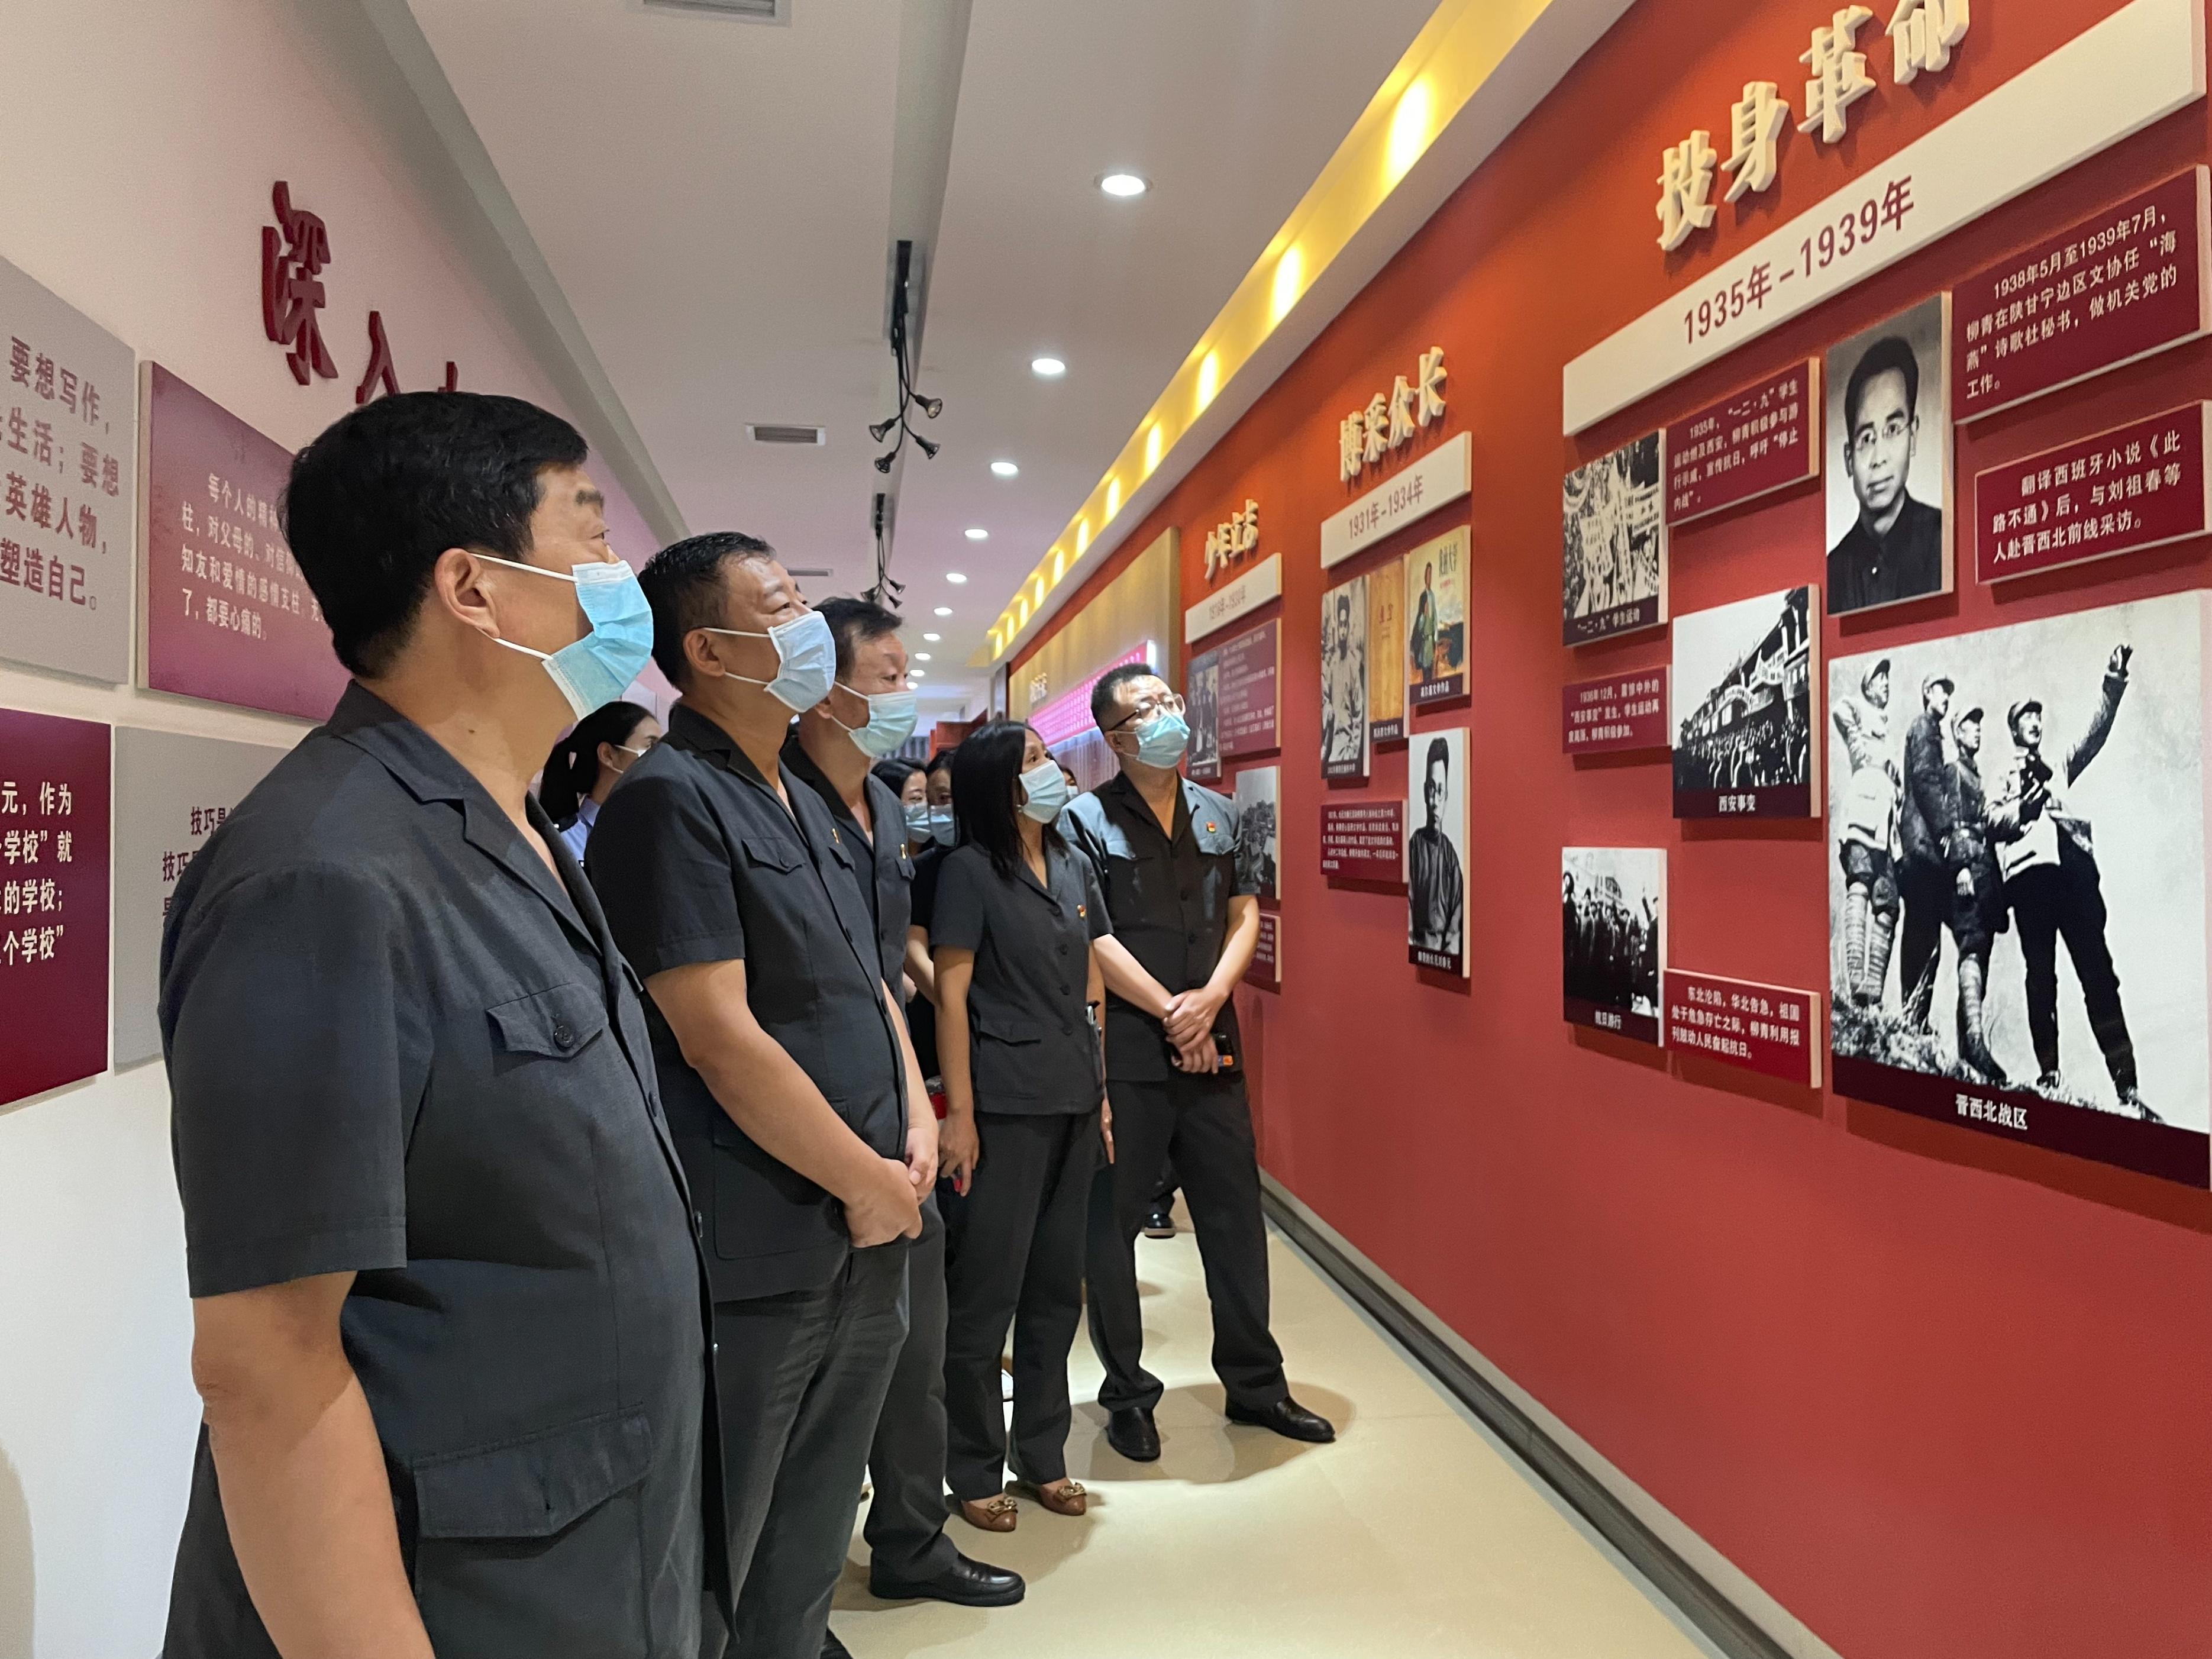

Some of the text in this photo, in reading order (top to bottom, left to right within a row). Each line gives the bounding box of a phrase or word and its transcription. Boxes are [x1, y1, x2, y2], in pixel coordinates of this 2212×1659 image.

[1656, 0, 1970, 251] 投身革命
[1684, 175, 1914, 344] 1935年-1939年
[1994, 205, 2165, 299] 1938年5月至1939年7月，
[261, 180, 458, 404] 深入
[9, 335, 109, 434] 要想写作，
[1966, 373, 2000, 399] 工作。
[0, 406, 119, 497] 生活；要想
[2022, 430, 2181, 498] 翻译西班牙小说《此
[5, 471, 107, 554] 英雄人物，
[1993, 463, 2181, 534] 路不通》后，与刘祖春等
[1993, 509, 2141, 564] 人赴晋西北前线采访。
[0, 537, 96, 610] 塑造自己。
[1, 781, 72, 815] 元，作为
[1718, 793, 1756, 813] 西安事变
[0, 830, 72, 865] 学校”就
[163, 850, 199, 882] 技巧
[0, 878, 62, 915] 的学校；
[0, 924, 64, 966] 个学校”
[1687, 986, 1800, 1022] 东北沦陷，华北告急，祖国
[1955, 1093, 2029, 1131] 晋西北战区
